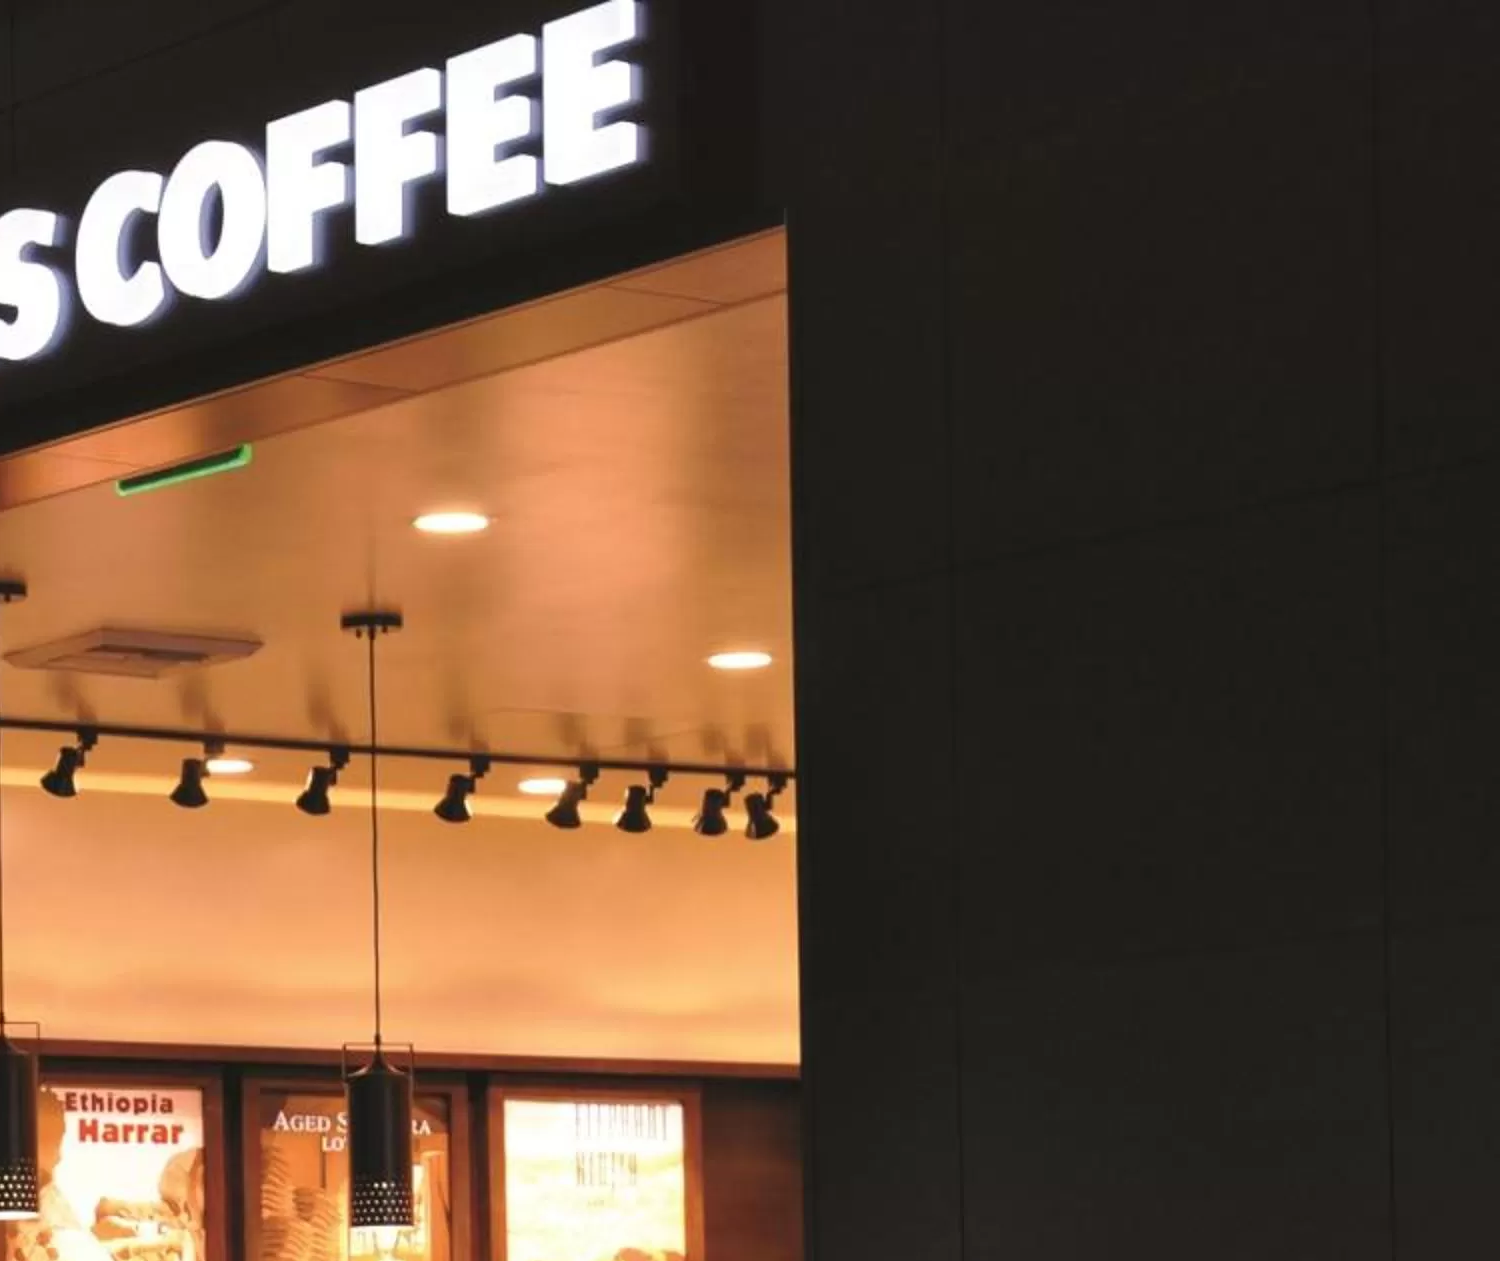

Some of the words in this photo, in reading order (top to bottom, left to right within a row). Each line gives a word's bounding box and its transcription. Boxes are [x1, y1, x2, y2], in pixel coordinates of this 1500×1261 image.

[75, 0, 644, 328] COFFEE
[64, 1091, 174, 1115] Ethiopia
[78, 1118, 184, 1144] Harrar
[273, 1109, 332, 1133] AGED
